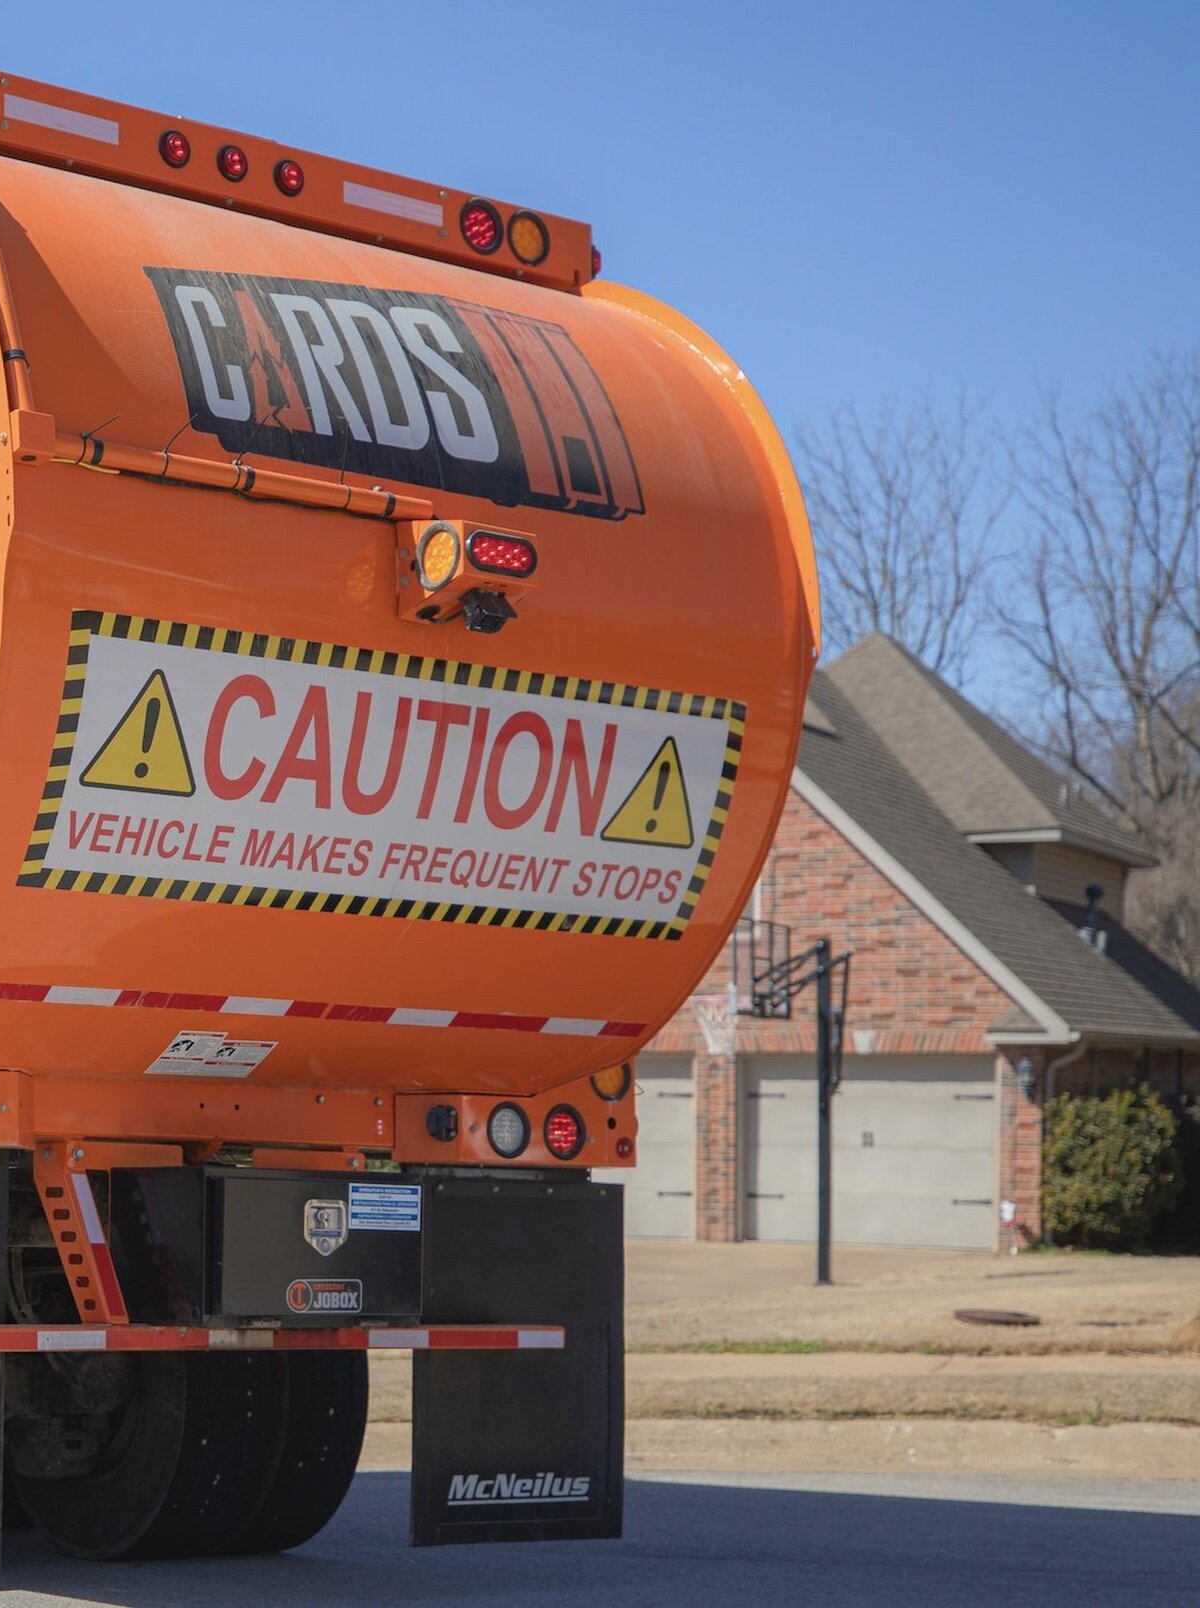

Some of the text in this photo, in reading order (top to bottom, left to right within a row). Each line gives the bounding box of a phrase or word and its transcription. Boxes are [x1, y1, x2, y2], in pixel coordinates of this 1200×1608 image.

[175, 285, 499, 463] CARDS
[204, 673, 618, 837] CAUTION
[68, 810, 683, 904] VEHICLE MAKES FREQUENT STOPS
[313, 1292, 358, 1308] JOBOX
[448, 1472, 591, 1500] McNeilus
